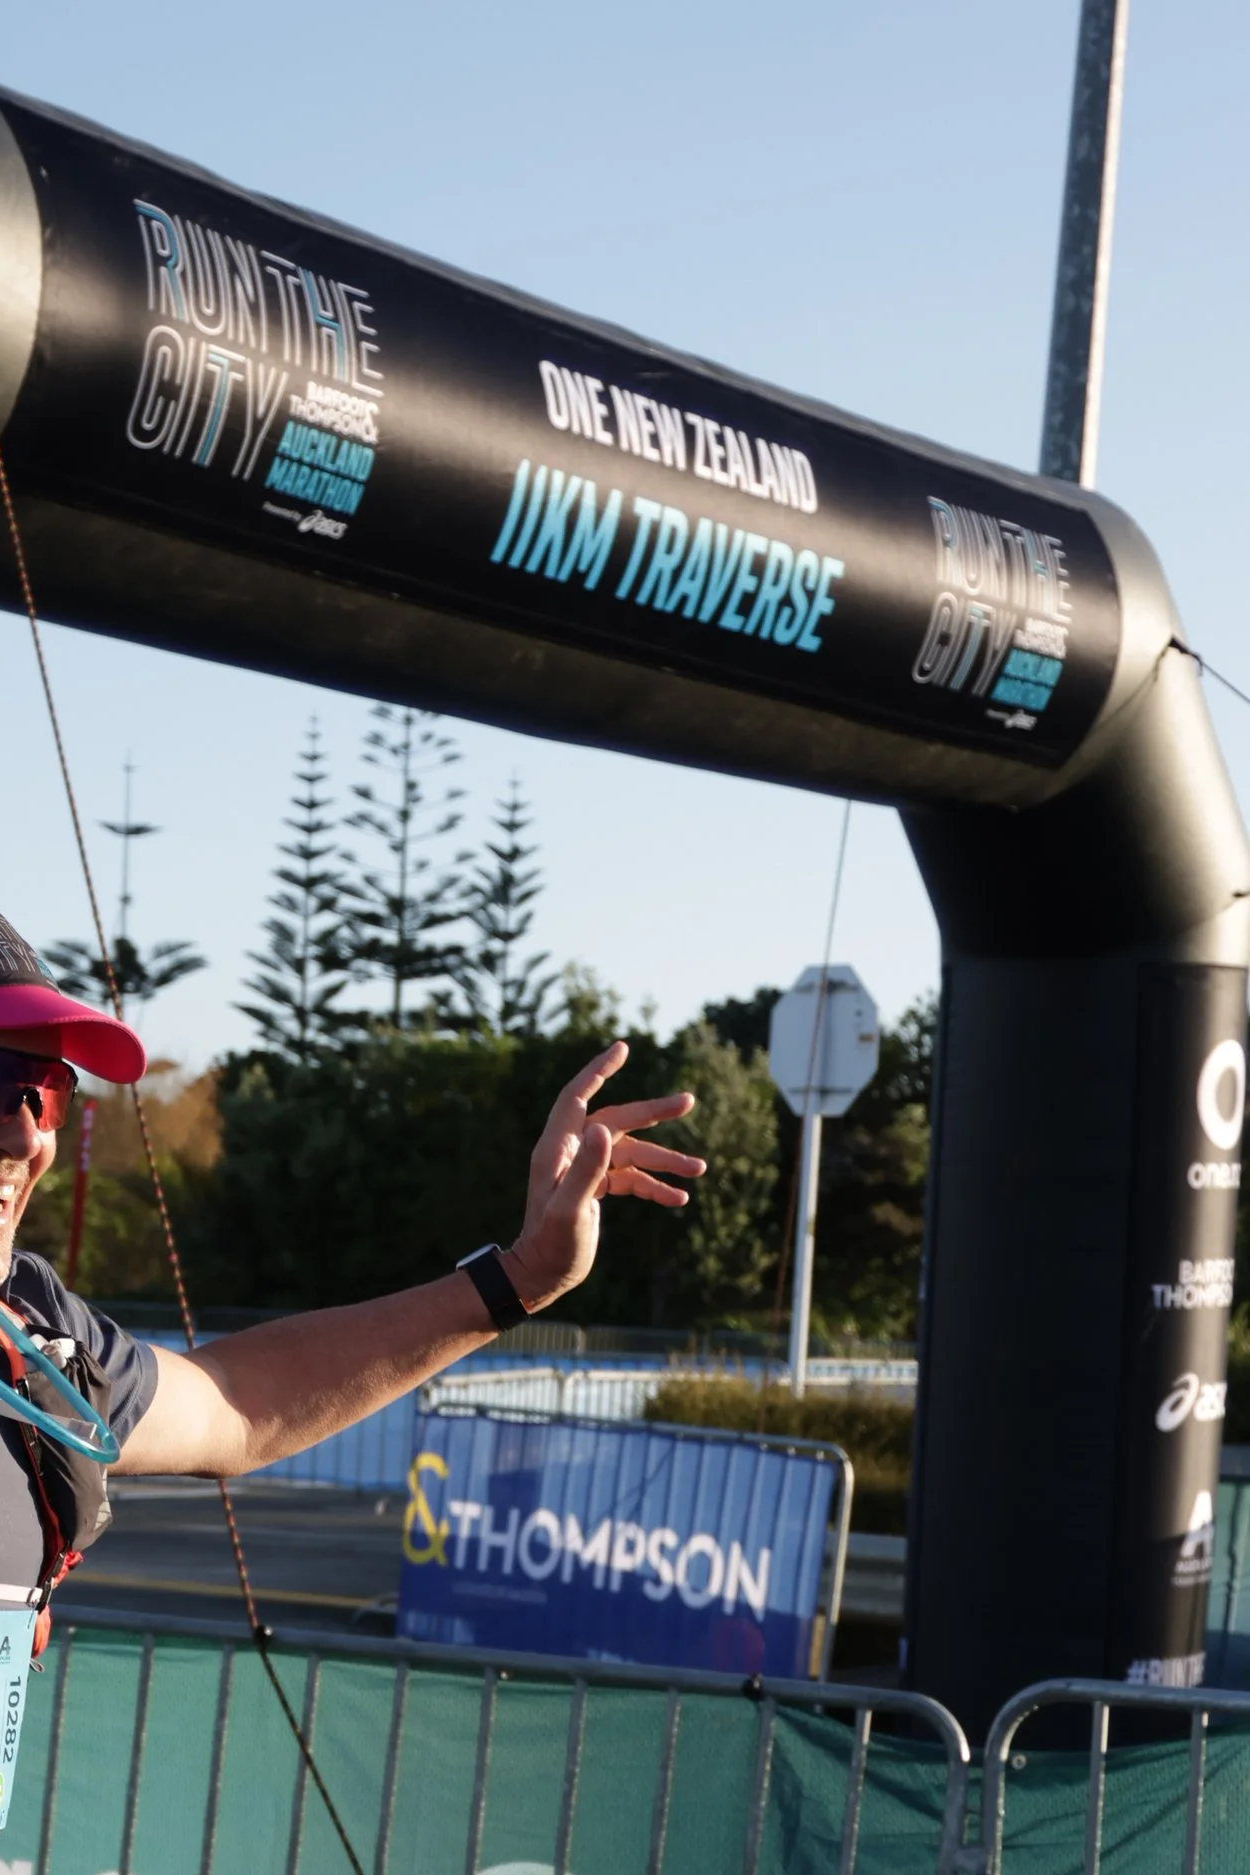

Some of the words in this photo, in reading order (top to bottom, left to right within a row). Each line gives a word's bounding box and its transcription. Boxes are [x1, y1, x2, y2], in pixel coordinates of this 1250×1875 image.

[134, 198, 268, 355] RUN
[260, 250, 384, 398] THE
[127, 325, 289, 482] CITY
[277, 420, 375, 482] AUCKLAND
[539, 360, 614, 447] ONE
[609, 384, 687, 472] NEW
[684, 411, 819, 514] ZEALAND
[264, 455, 366, 517] MARATHON
[489, 458, 623, 591] 11KM
[615, 496, 845, 652] TRAVERSE
[451, 1501, 772, 1623] THOMPSON
[2, 1675, 22, 1764] 10282
